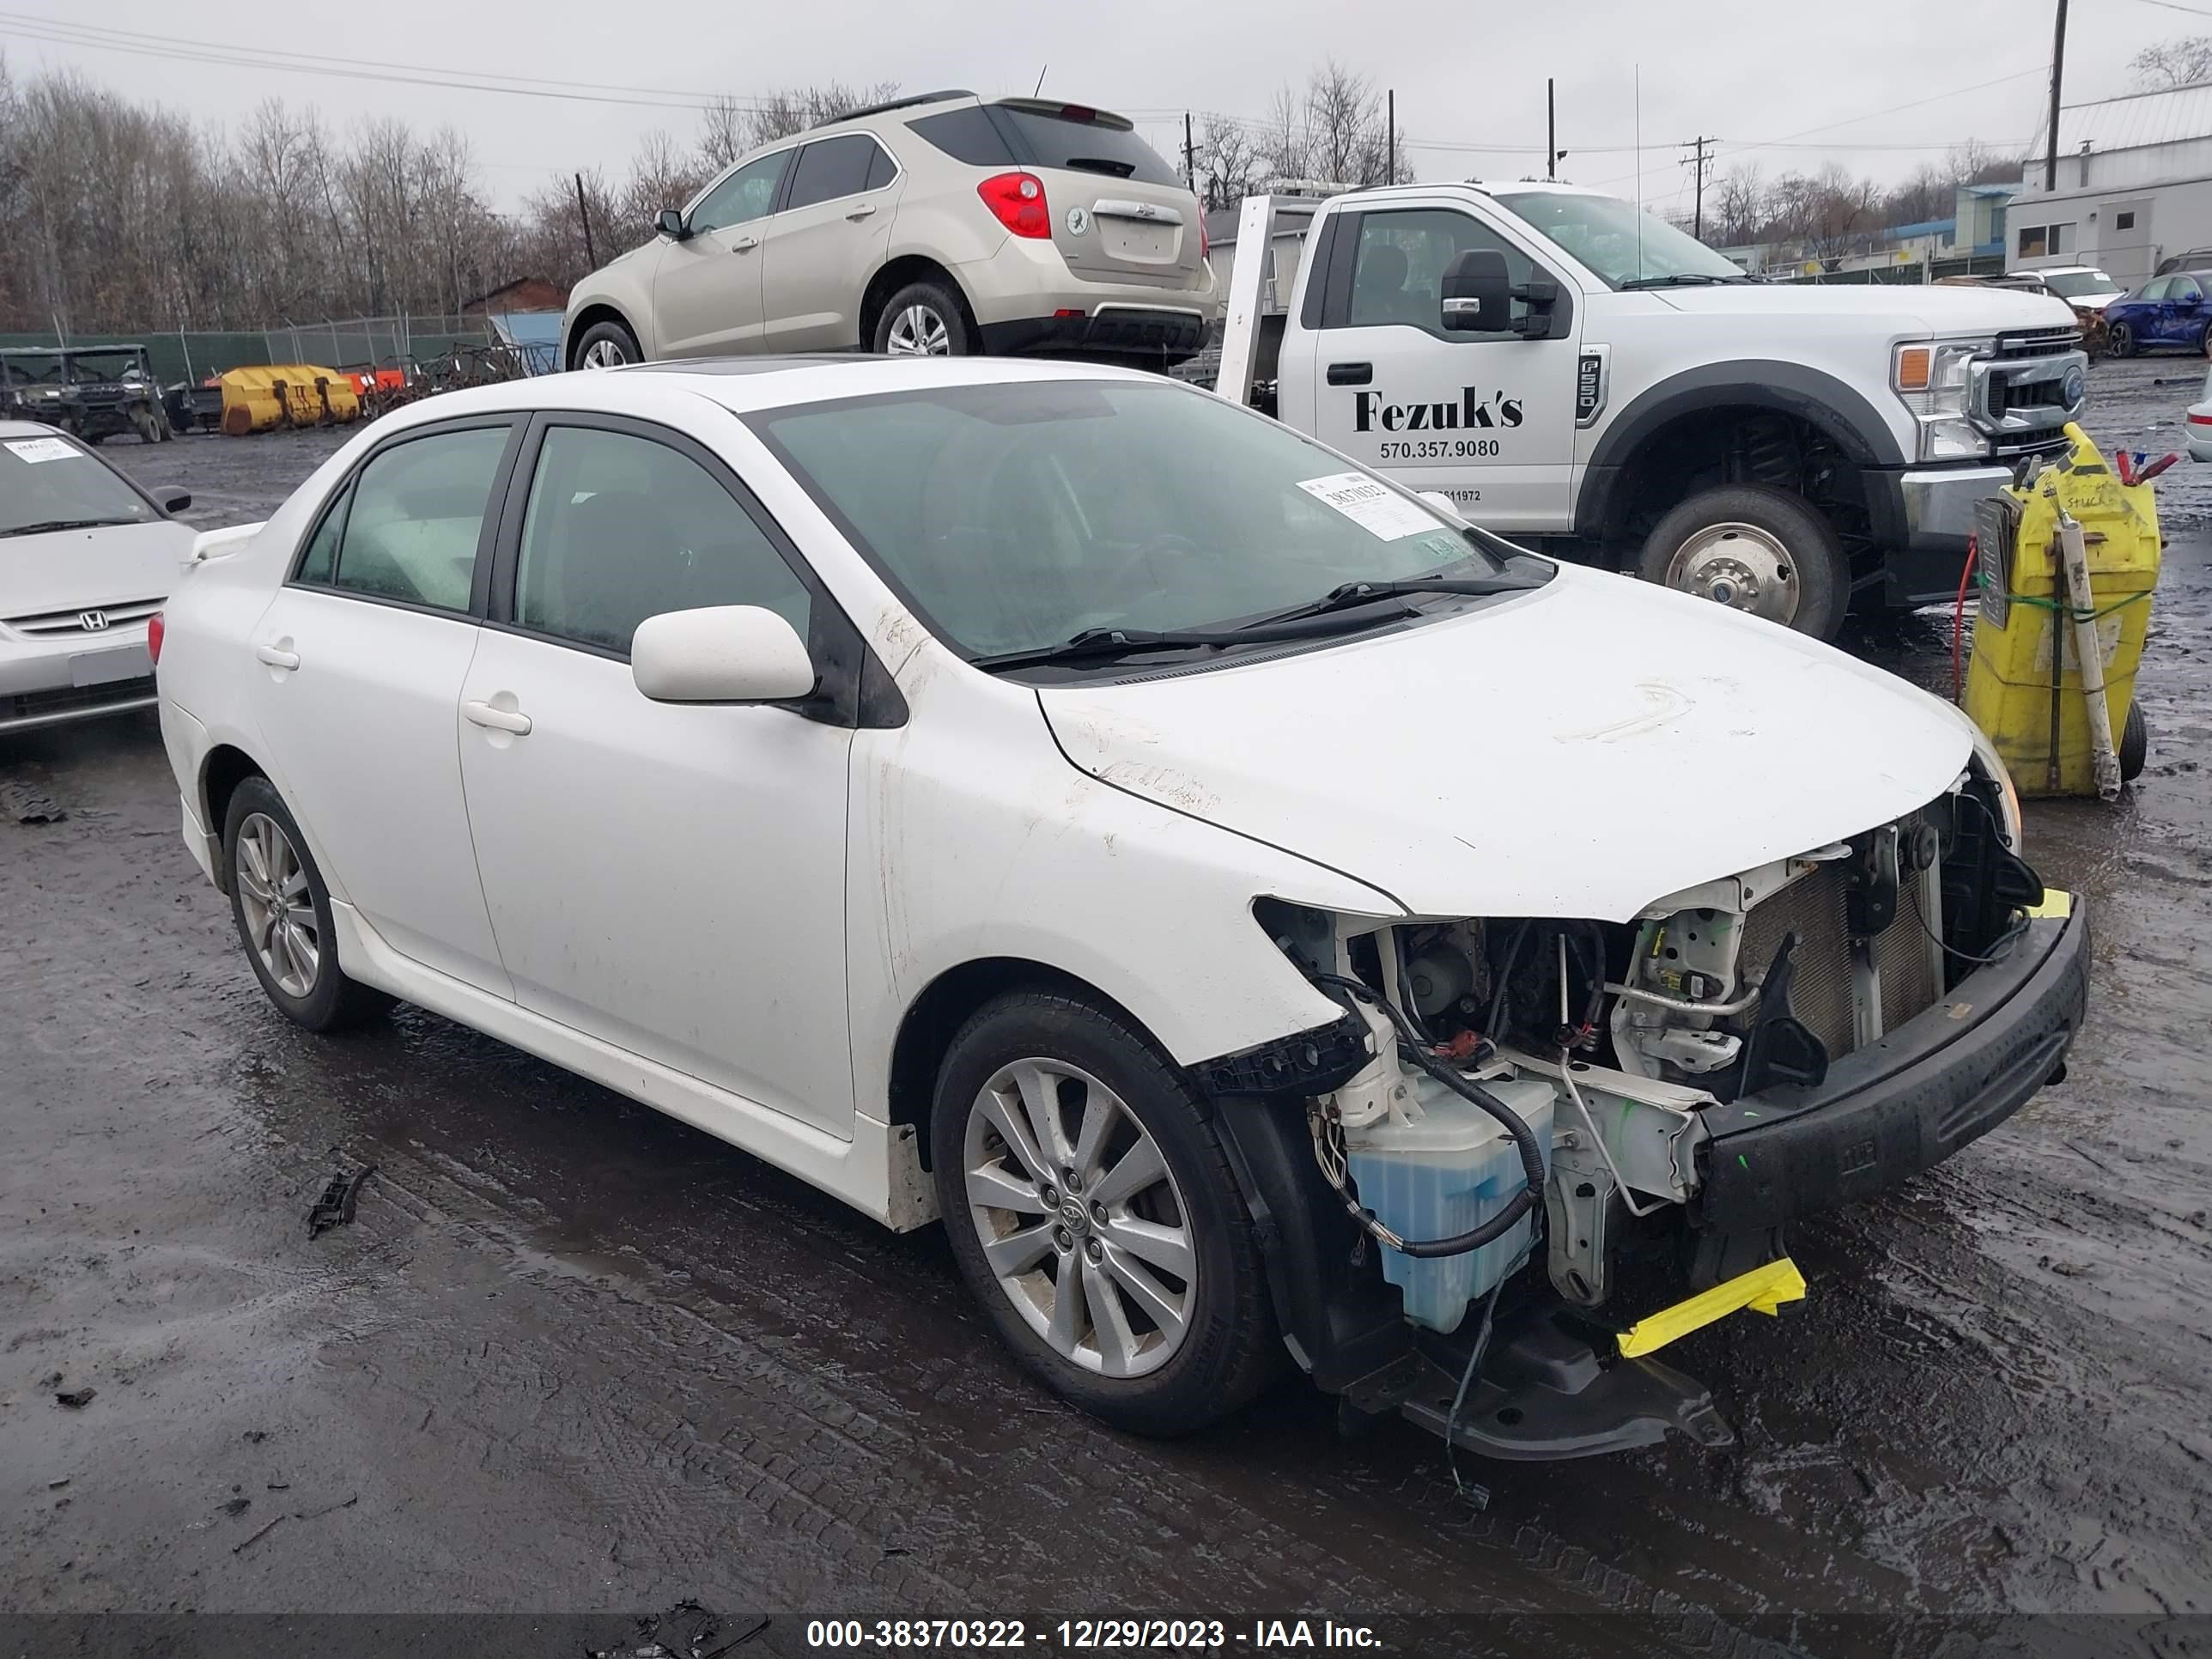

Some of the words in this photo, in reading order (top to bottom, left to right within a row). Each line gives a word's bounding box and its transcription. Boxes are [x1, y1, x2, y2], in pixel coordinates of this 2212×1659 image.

[1580, 361, 1599, 407] F550
[1352, 386, 1523, 433] Fezuk's
[1380, 440, 1499, 459] 570.357.9080
[1325, 484, 1387, 505] 38370322
[1437, 490, 1481, 501] 611972
